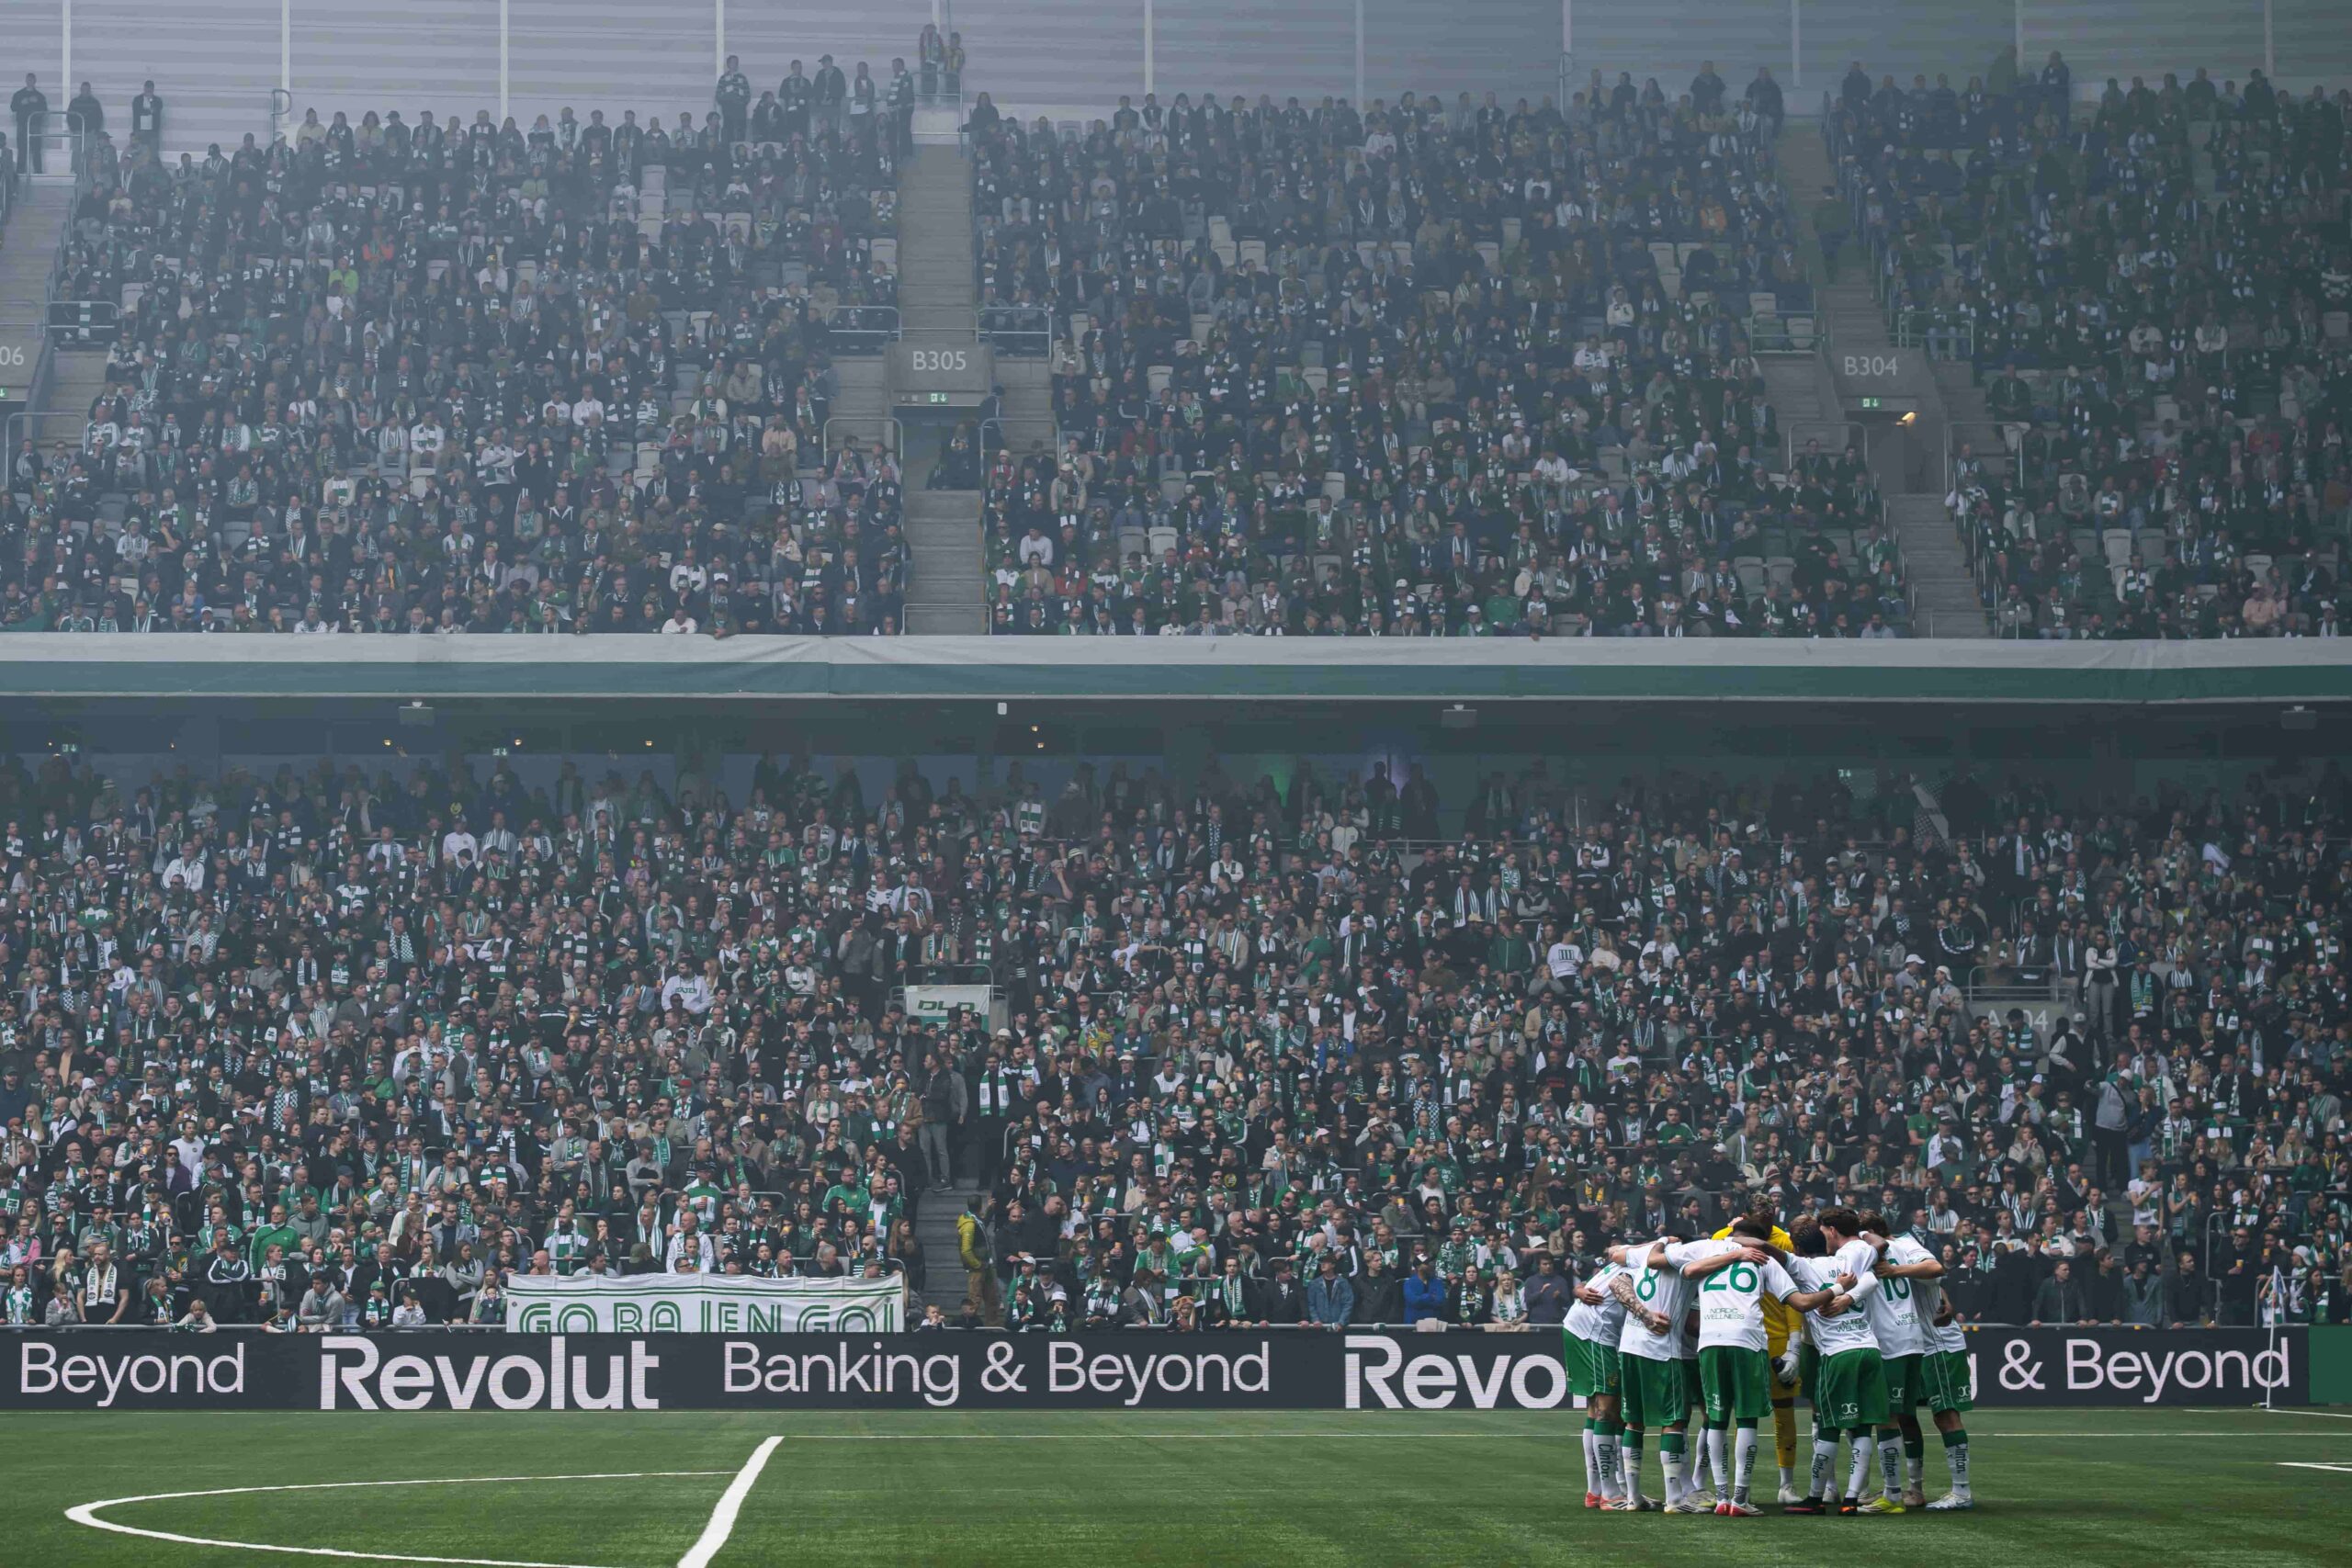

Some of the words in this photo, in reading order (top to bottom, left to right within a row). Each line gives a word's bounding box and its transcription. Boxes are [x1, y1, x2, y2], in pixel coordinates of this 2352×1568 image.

[912, 351, 967, 370] B305
[1844, 356, 1899, 376] B304
[1988, 1009, 2049, 1032] A04
[1636, 1267, 1661, 1302] 8
[1703, 1261, 1759, 1293] 26
[21, 1342, 244, 1406] Beyond
[321, 1336, 660, 1409] Revolut
[724, 1342, 959, 1406] Banking
[980, 1342, 1027, 1392] &
[1048, 1341, 1270, 1405] Beyond
[1345, 1335, 1587, 1409] Revo
[1999, 1339, 2045, 1391] &
[2066, 1337, 2290, 1403] Beyond
